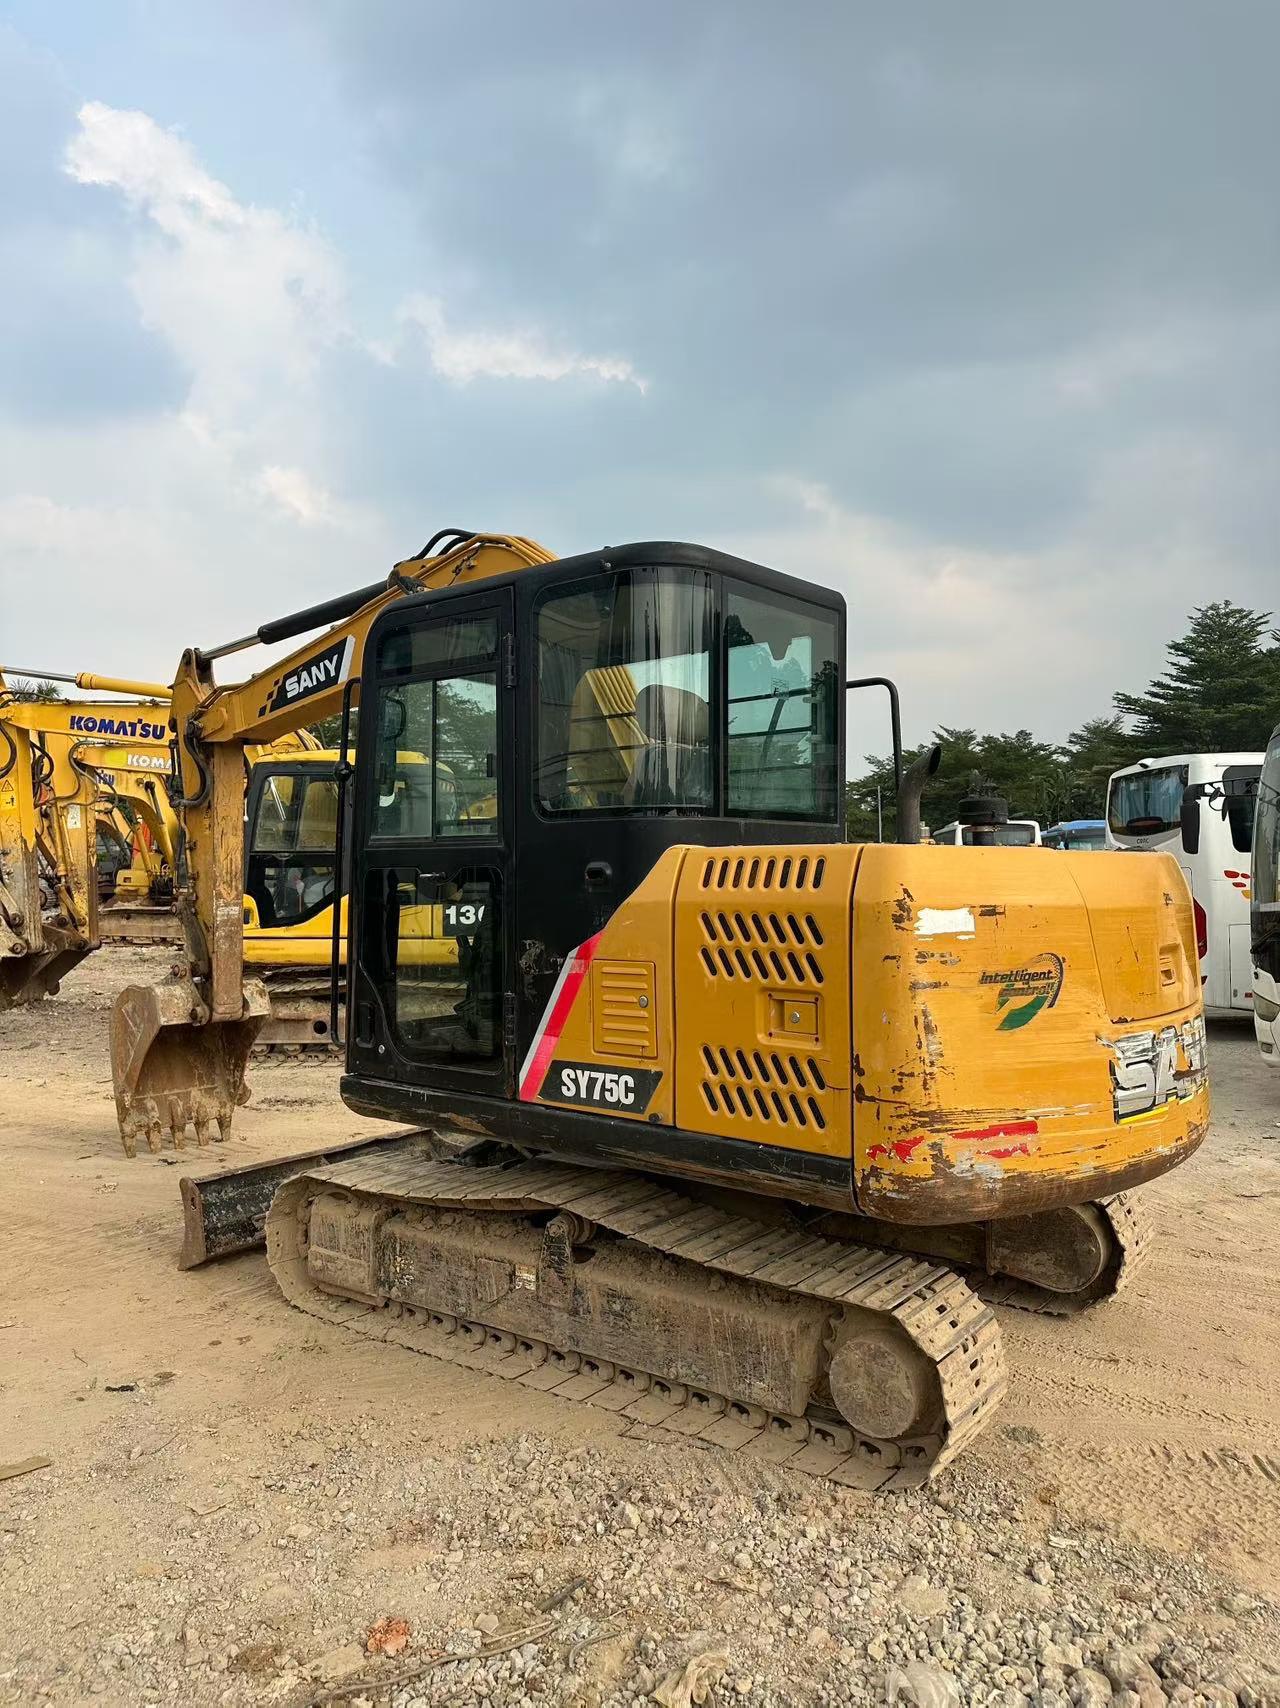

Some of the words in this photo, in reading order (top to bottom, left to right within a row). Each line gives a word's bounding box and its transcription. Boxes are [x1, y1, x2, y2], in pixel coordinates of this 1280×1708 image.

[285, 654, 338, 699] SANY
[69, 715, 166, 740] KOMATSU
[560, 1068, 635, 1105] SY75C
